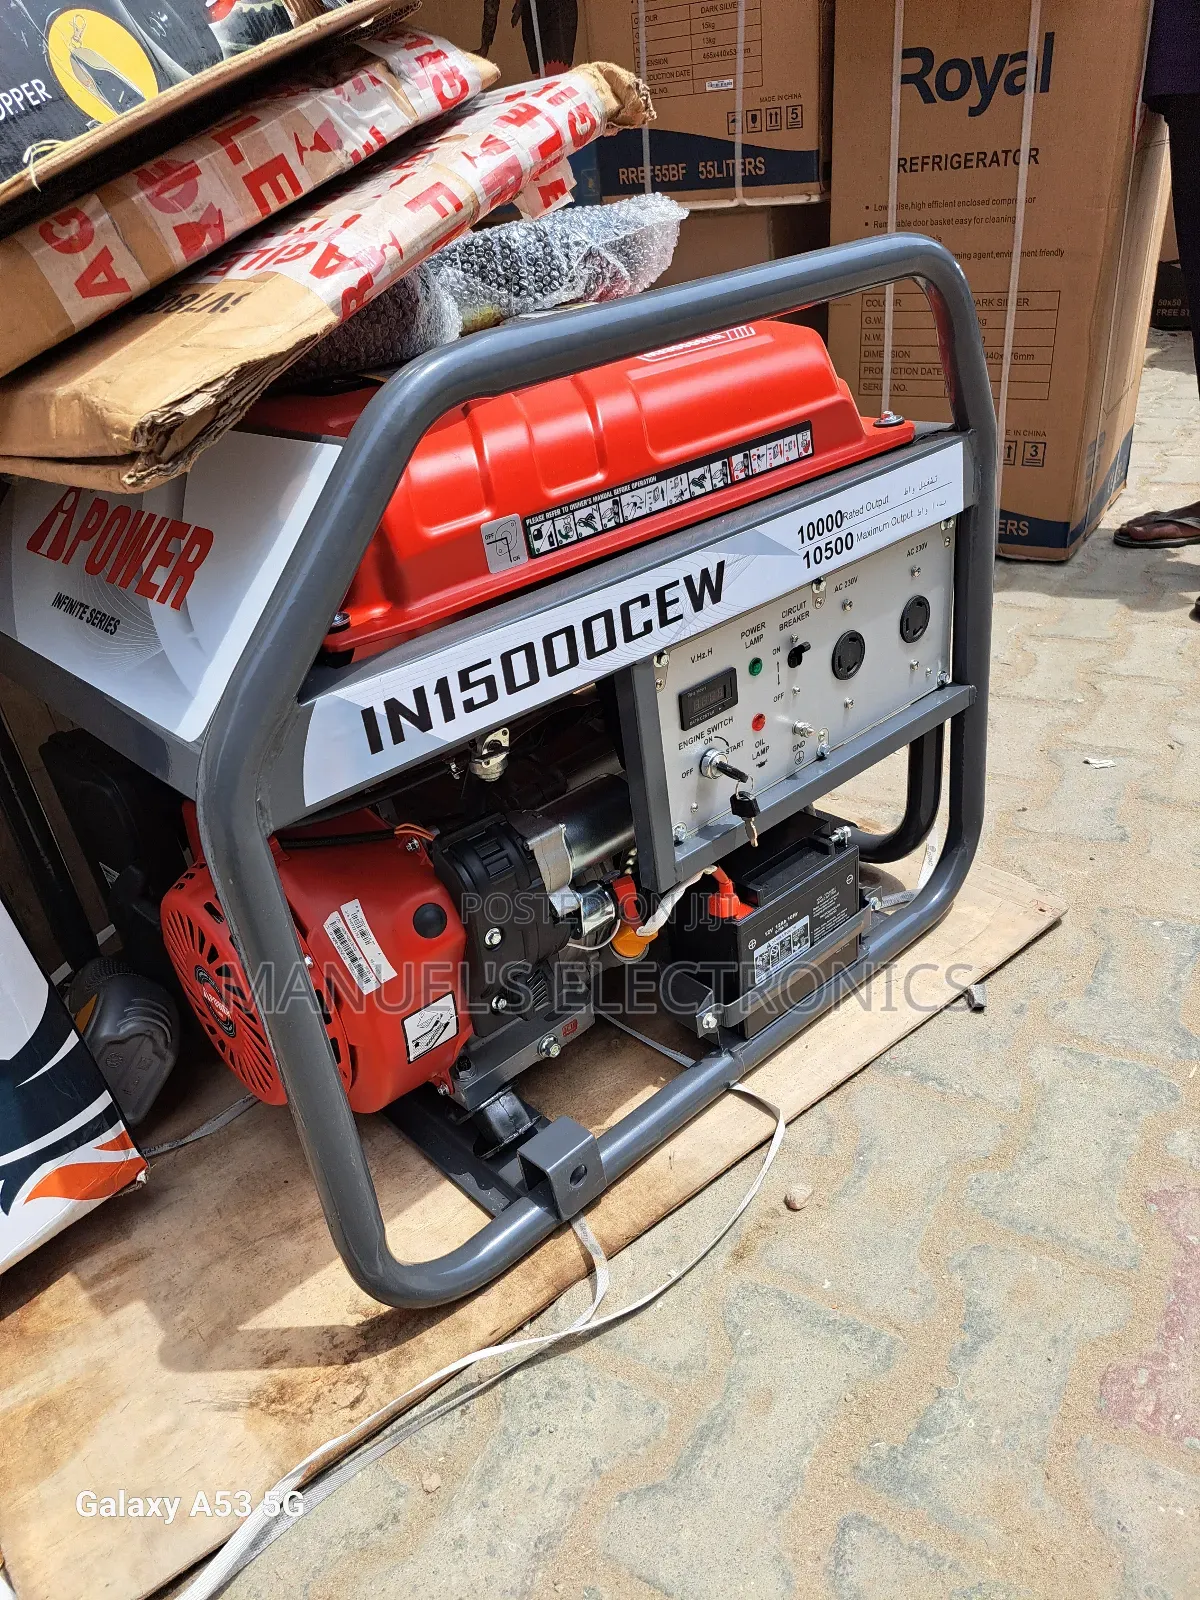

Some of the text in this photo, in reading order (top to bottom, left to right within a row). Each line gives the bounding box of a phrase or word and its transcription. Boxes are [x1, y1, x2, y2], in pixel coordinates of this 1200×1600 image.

[720, 1, 738, 10] SILVE
[675, 69, 692, 78] DATE
[900, 32, 1055, 118] Royal
[784, 93, 802, 101] CHINA
[791, 108, 799, 120] 5
[912, 218, 929, 228] door
[930, 217, 954, 227] basket
[955, 217, 972, 227] easy
[973, 215, 984, 225] for
[996, 298, 1030, 307] SILER
[920, 367, 944, 376] DATE
[1022, 429, 1047, 438] CHINA
[1029, 444, 1039, 458] 3
[525, 513, 545, 526] PLEASE
[545, 508, 561, 521] REFER
[797, 494, 889, 544] 10000 Rated Output
[802, 509, 914, 570] 10500 Maximum Output
[906, 547, 915, 557] AC
[834, 582, 843, 593] AC
[52, 591, 121, 636] INFINITE SERIES
[781, 600, 807, 619] CIRCUIT
[779, 610, 810, 631] BREAKER
[740, 621, 766, 640] POWER
[744, 633, 764, 649] LAMP
[361, 560, 726, 755] IN15000CEW
[772, 646, 781, 656] ON
[773, 691, 785, 703] OFF
[678, 733, 706, 751] ENGINE
[706, 715, 734, 736] SWITCH
[703, 736, 713, 746] ON
[725, 740, 745, 755] START
[754, 738, 766, 749] OIL
[792, 740, 806, 753] GND
[751, 745, 770, 761] LAMP
[681, 767, 694, 779] OFF
